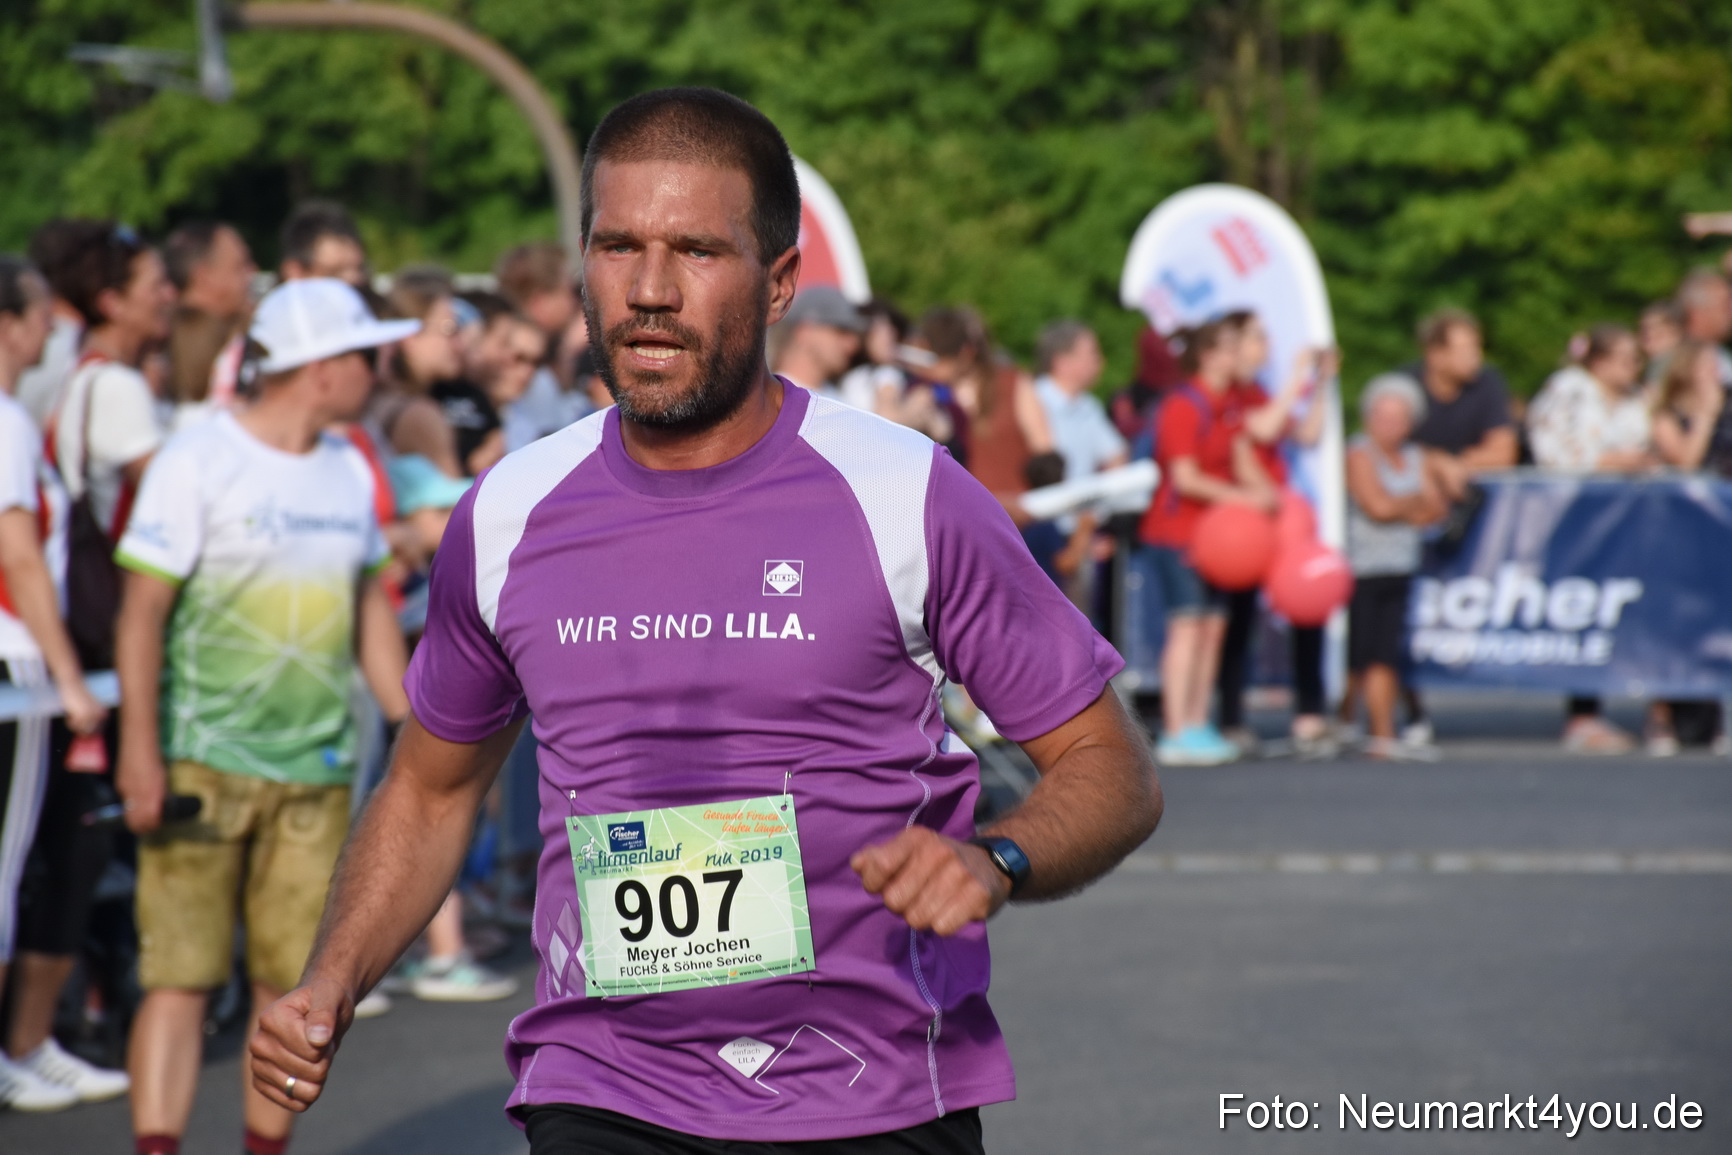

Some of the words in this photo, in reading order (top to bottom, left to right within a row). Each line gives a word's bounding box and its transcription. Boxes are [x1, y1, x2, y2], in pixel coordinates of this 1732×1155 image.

[556, 616, 617, 644] WIR
[630, 613, 712, 640] SIND
[725, 612, 816, 641] LILA.
[703, 809, 743, 821] Gesunde
[746, 810, 779, 821] Firmen
[722, 821, 751, 835] laufen
[598, 842, 682, 867] firmenlauf
[740, 846, 783, 864] 2019
[600, 866, 633, 874] neumarkt
[614, 868, 743, 943] 907
[627, 946, 678, 964] Meyer
[683, 937, 750, 956] Jochen
[620, 963, 658, 977] FUCHS
[662, 963, 671, 973] &
[674, 960, 713, 972] Söhne
[716, 953, 763, 967] Service
[732, 1048, 761, 1056] einfach
[738, 1056, 756, 1064] LILA
